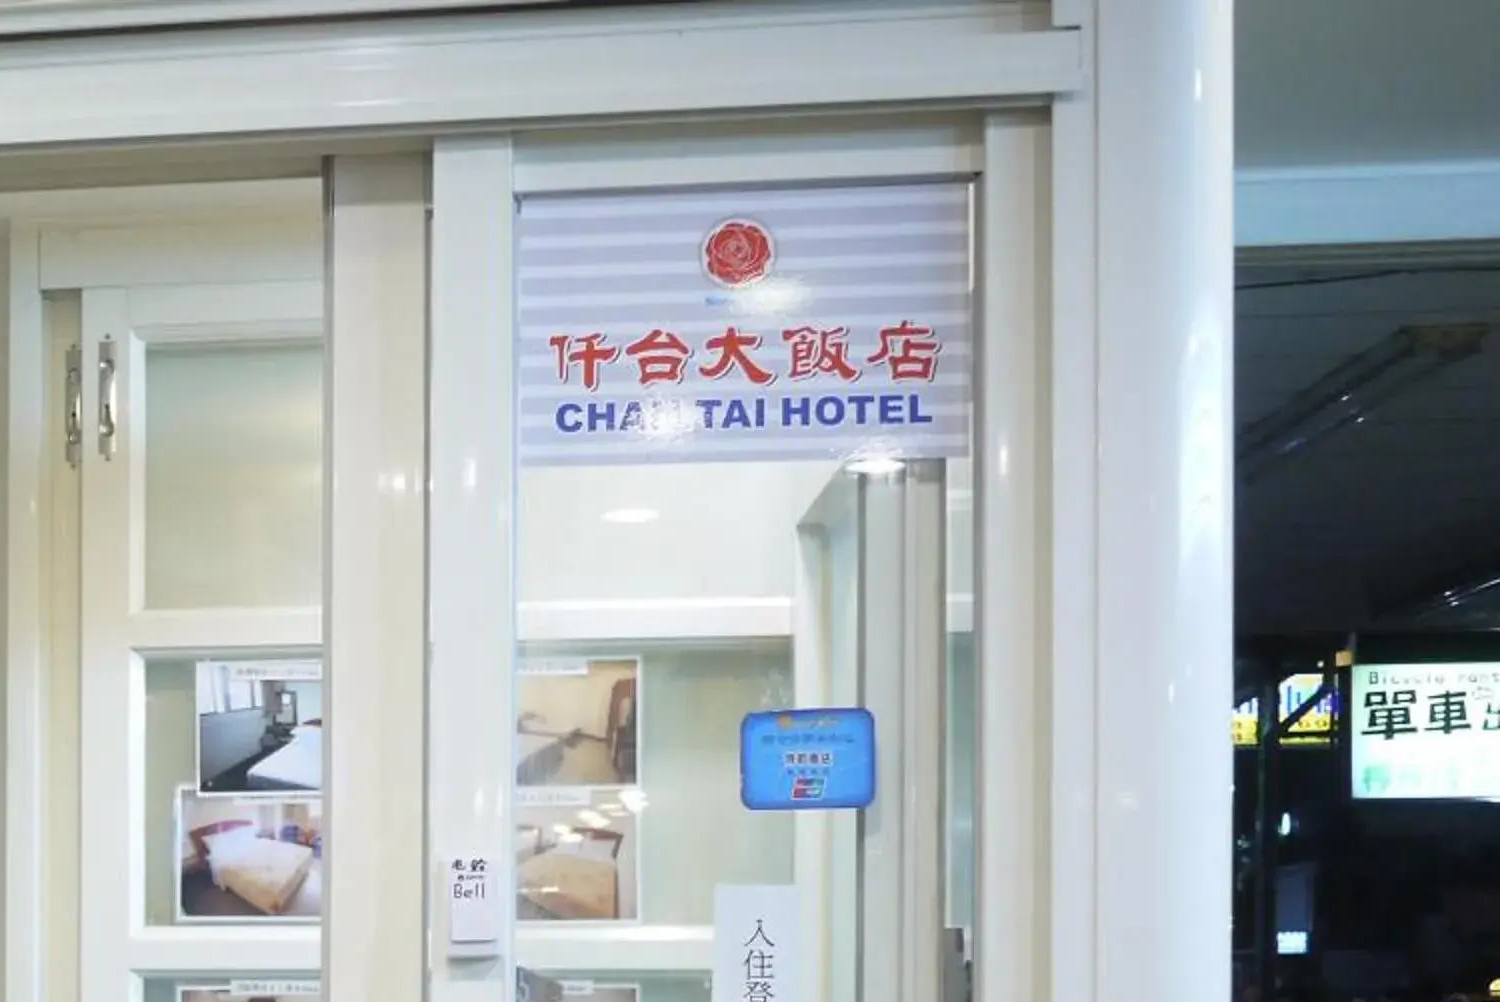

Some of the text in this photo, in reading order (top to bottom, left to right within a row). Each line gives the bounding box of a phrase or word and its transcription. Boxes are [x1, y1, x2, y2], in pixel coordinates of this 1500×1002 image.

[549, 320, 942, 392] 仟台大飯店
[696, 400, 766, 430] TAI
[781, 395, 933, 428] HOTEL
[453, 882, 485, 899] Bell
